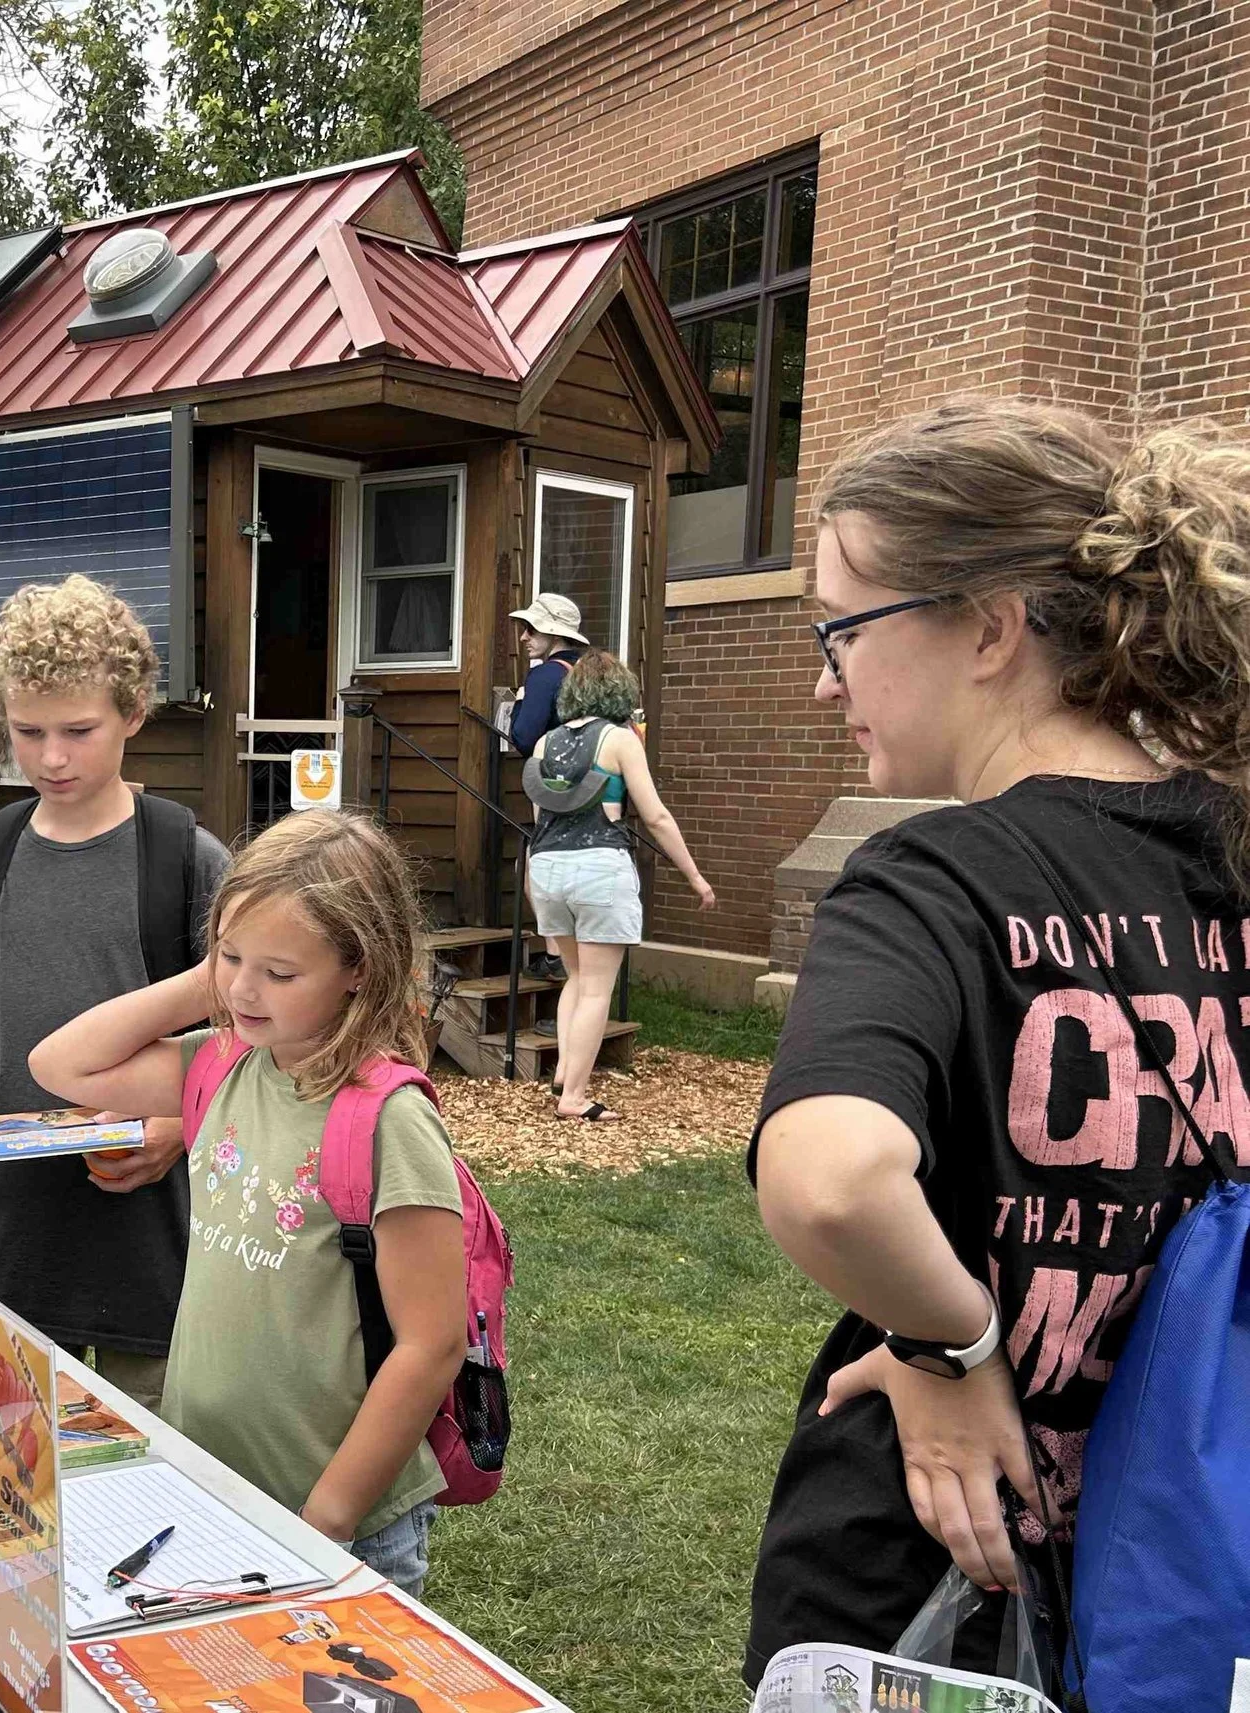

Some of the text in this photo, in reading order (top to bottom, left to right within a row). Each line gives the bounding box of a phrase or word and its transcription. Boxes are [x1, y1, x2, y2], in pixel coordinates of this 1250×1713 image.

[1007, 913, 1169, 969] DON'T
[1008, 989, 1250, 1170] CRA
[204, 1223, 226, 1251] of
[220, 1235, 232, 1251] a
[234, 1234, 288, 1272] Kind
[993, 1196, 1161, 1249] THAT'S
[9, 1627, 51, 1689] Drawings
